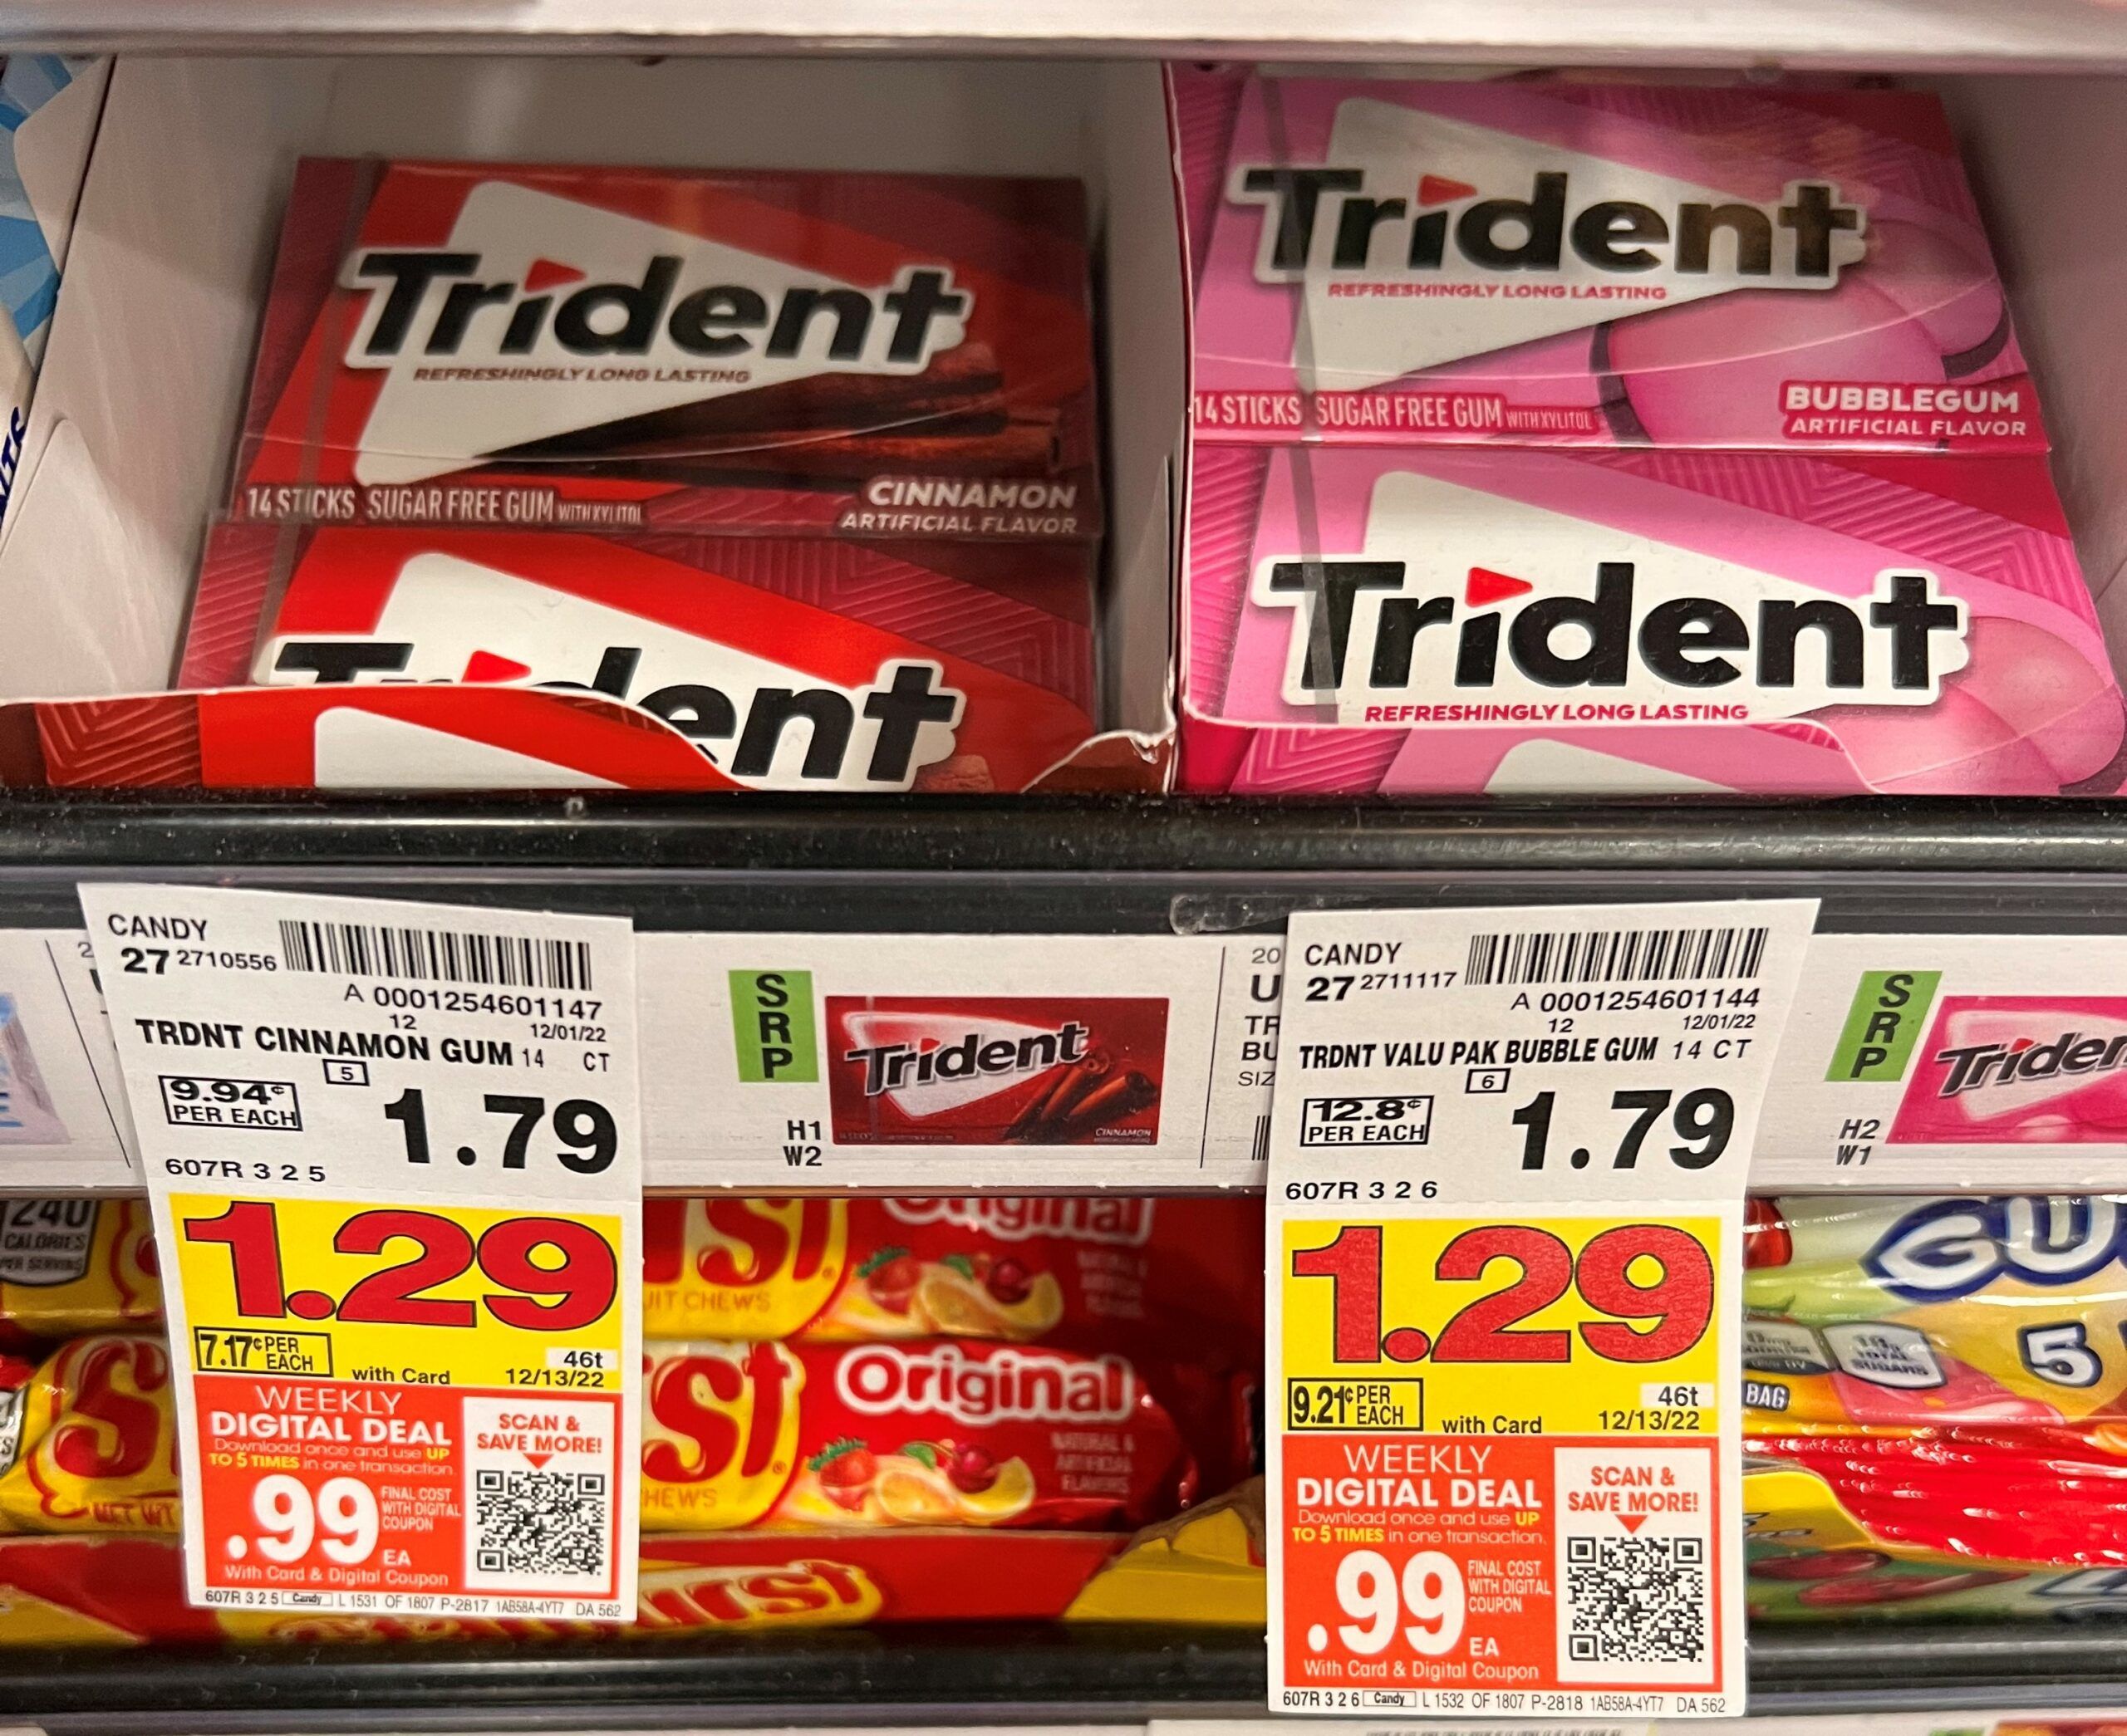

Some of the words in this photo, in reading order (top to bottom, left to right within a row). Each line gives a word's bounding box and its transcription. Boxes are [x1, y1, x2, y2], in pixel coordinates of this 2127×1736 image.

[1243, 169, 1858, 277] Trident
[1329, 282, 1500, 298] REFRESHINGLY
[1503, 284, 1566, 299] LONG
[1570, 285, 1667, 301] LASTING
[356, 253, 965, 364] Trident
[413, 366, 582, 382] REFRESHINGLY
[585, 368, 649, 382] LONG
[654, 369, 752, 384] LASTING
[1786, 386, 2019, 414] BUBBLEGUM
[1194, 397, 1217, 424] 14
[1222, 396, 1300, 425] STICKS
[1317, 396, 1388, 427] SUGAR
[1395, 397, 1449, 427] FREE
[1456, 398, 1502, 429] GUM
[1506, 409, 1540, 429] WITH
[1540, 410, 1593, 430] XYLITOL
[1791, 419, 1926, 436] ARTIFICIAL
[1930, 419, 2026, 437] FLAVOR
[248, 490, 272, 517] 14
[277, 489, 356, 520] STICKS
[367, 490, 441, 521] SUGAR
[447, 491, 501, 521] FREE
[505, 491, 554, 522] GUM
[868, 480, 1078, 510] CINNAMON
[841, 512, 974, 533] ARTIFICIAL
[980, 516, 1078, 534] FLAVOR
[1270, 561, 1959, 691] Trident
[1364, 704, 1560, 723] REFRESHINGLY
[1562, 705, 1635, 722] LONG
[1640, 705, 1749, 721] LASTING
[108, 914, 208, 941] CANDY
[121, 948, 169, 974] 27
[177, 950, 277, 971] 2710556
[1304, 942, 1402, 966] CANDY
[1305, 976, 1355, 1002] 27
[1360, 972, 1457, 990] 2711117
[374, 987, 602, 1020] 0001254601147
[1510, 993, 1530, 1011] A
[1540, 988, 1761, 1012] 0001254601144
[389, 1014, 417, 1030] 12
[530, 1023, 607, 1043] 12/01/22
[1548, 1018, 1574, 1032] 12
[1682, 1014, 1756, 1030] 12/01/22
[135, 1018, 243, 1049] TRDNT
[255, 1026, 430, 1061] CINNAMON
[441, 1038, 513, 1066] GUM
[522, 1048, 544, 1068] 14
[583, 1052, 611, 1072] CT
[1299, 1043, 1377, 1069] TRDNT
[1384, 1042, 1446, 1067] VALU
[1450, 1040, 1501, 1065] PAK
[1504, 1037, 1600, 1064] BUBBLE
[1604, 1037, 1659, 1061] GUM
[1673, 1040, 1702, 1060] 14
[1712, 1039, 1752, 1059] CT
[847, 1022, 1089, 1095] Trident
[340, 1067, 355, 1081] 5
[1481, 1074, 1496, 1090] 6
[173, 1105, 222, 1123] PER
[231, 1107, 298, 1127] EACH
[384, 1088, 618, 1174] 1.79
[786, 1121, 823, 1140] H1
[1094, 1127, 1152, 1137] CINNAMON
[1308, 1125, 1354, 1143] PER
[1363, 1124, 1427, 1142] EACH
[1511, 1087, 1735, 1170] 1.79
[1839, 1119, 1881, 1140] H2
[783, 1145, 823, 1166] W2
[1835, 1145, 1873, 1165] W1
[165, 1158, 243, 1179] 607R
[253, 1163, 271, 1180] 3
[281, 1165, 299, 1181] 2
[308, 1165, 327, 1183] 5
[1285, 1181, 1358, 1200] 607R
[1368, 1181, 1386, 1199] 3
[1394, 1181, 1412, 1199] 2
[1421, 1181, 1438, 1199] 6
[183, 1201, 618, 1331] 1.29
[683, 1291, 772, 1312] CHEWS
[1291, 1224, 1715, 1363] 1.29
[265, 1336, 299, 1354] PER
[2021, 1322, 2102, 1386] 5
[266, 1353, 314, 1371] EACH
[563, 1351, 604, 1369] 46t
[352, 1366, 395, 1383] with
[402, 1368, 451, 1385] Card
[505, 1369, 605, 1388] 12/13/22
[837, 1346, 1132, 1424] Original
[255, 1385, 403, 1415] WEEKLY
[1356, 1385, 1391, 1405] PER
[1658, 1385, 1699, 1406] 46t
[1746, 1382, 1786, 1410] BAG
[499, 1413, 559, 1432] SCAN
[566, 1415, 581, 1432] &
[1356, 1405, 1404, 1425] EACH
[1442, 1415, 1486, 1434] with
[1492, 1415, 1543, 1434] Card
[1599, 1410, 1700, 1430] 12/13/22
[210, 1411, 352, 1442] DIGITAL
[362, 1417, 453, 1446] DEAL
[477, 1433, 528, 1451] SAVE
[535, 1435, 602, 1454] MORE!
[1343, 1444, 1493, 1474] WEEKLY
[1590, 1466, 1653, 1486] SCAN
[1659, 1467, 1676, 1486] &
[1297, 1478, 1439, 1507] DIGITAL
[1450, 1479, 1542, 1508] DEAL
[1568, 1492, 1620, 1512] SAVE
[1628, 1492, 1699, 1513] MORE!
[228, 1474, 381, 1564] .99
[1298, 1509, 1386, 1525] Download
[1390, 1513, 1436, 1525] once
[1440, 1511, 1476, 1526] and
[1480, 1514, 1511, 1526] use
[1515, 1511, 1540, 1526] UP
[1292, 1527, 1317, 1542] TO
[1319, 1526, 1332, 1543] 5
[1334, 1527, 1385, 1542] TIMES
[1388, 1528, 1405, 1543] in
[1408, 1531, 1443, 1543] one
[1467, 1560, 1503, 1577] FINAL
[1506, 1560, 1542, 1577] COST
[1467, 1578, 1500, 1595] WITH
[1503, 1579, 1552, 1596] DIGITAL
[1306, 1548, 1466, 1655] .99
[1467, 1596, 1523, 1613] COUPON
[1469, 1637, 1500, 1657] EA
[1304, 1660, 1343, 1677] With
[1348, 1660, 1388, 1678] Card
[1393, 1662, 1407, 1678] &
[1413, 1661, 1466, 1682] Digital
[1472, 1663, 1539, 1683] Coupon
[1283, 1691, 1320, 1707] 607R
[1373, 1692, 1406, 1707] Candy
[1434, 1693, 1464, 1709] 1532
[1471, 1694, 1491, 1709] OF
[1496, 1694, 1525, 1709] 1807
[1531, 1694, 1583, 1711] P-2818
[1677, 1696, 1697, 1713] DA
[1701, 1696, 1726, 1713] 562
